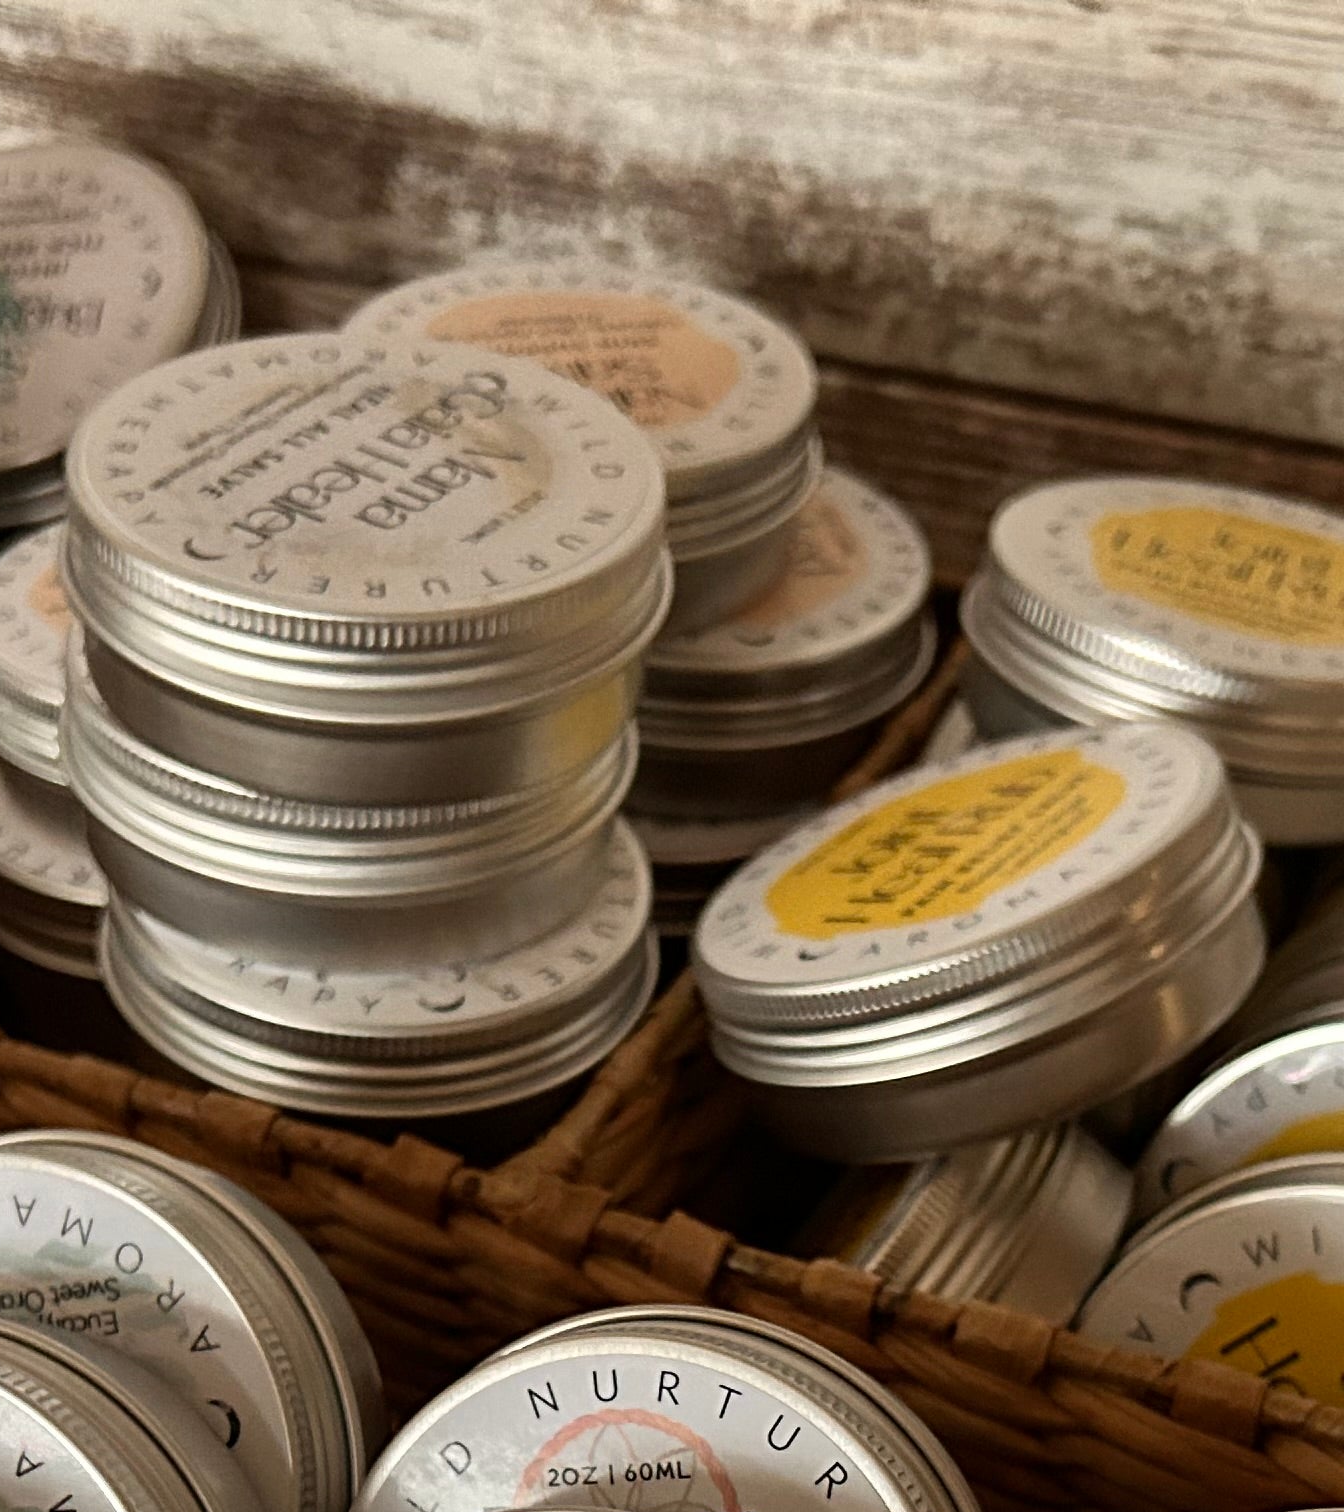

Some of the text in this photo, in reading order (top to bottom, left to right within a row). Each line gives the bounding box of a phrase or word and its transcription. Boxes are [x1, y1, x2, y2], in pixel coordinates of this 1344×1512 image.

[356, 445, 527, 529] Mama
[252, 506, 616, 598] NURTURER
[48, 1276, 122, 1316] Sweet
[623, 1460, 693, 1484] 60ML
